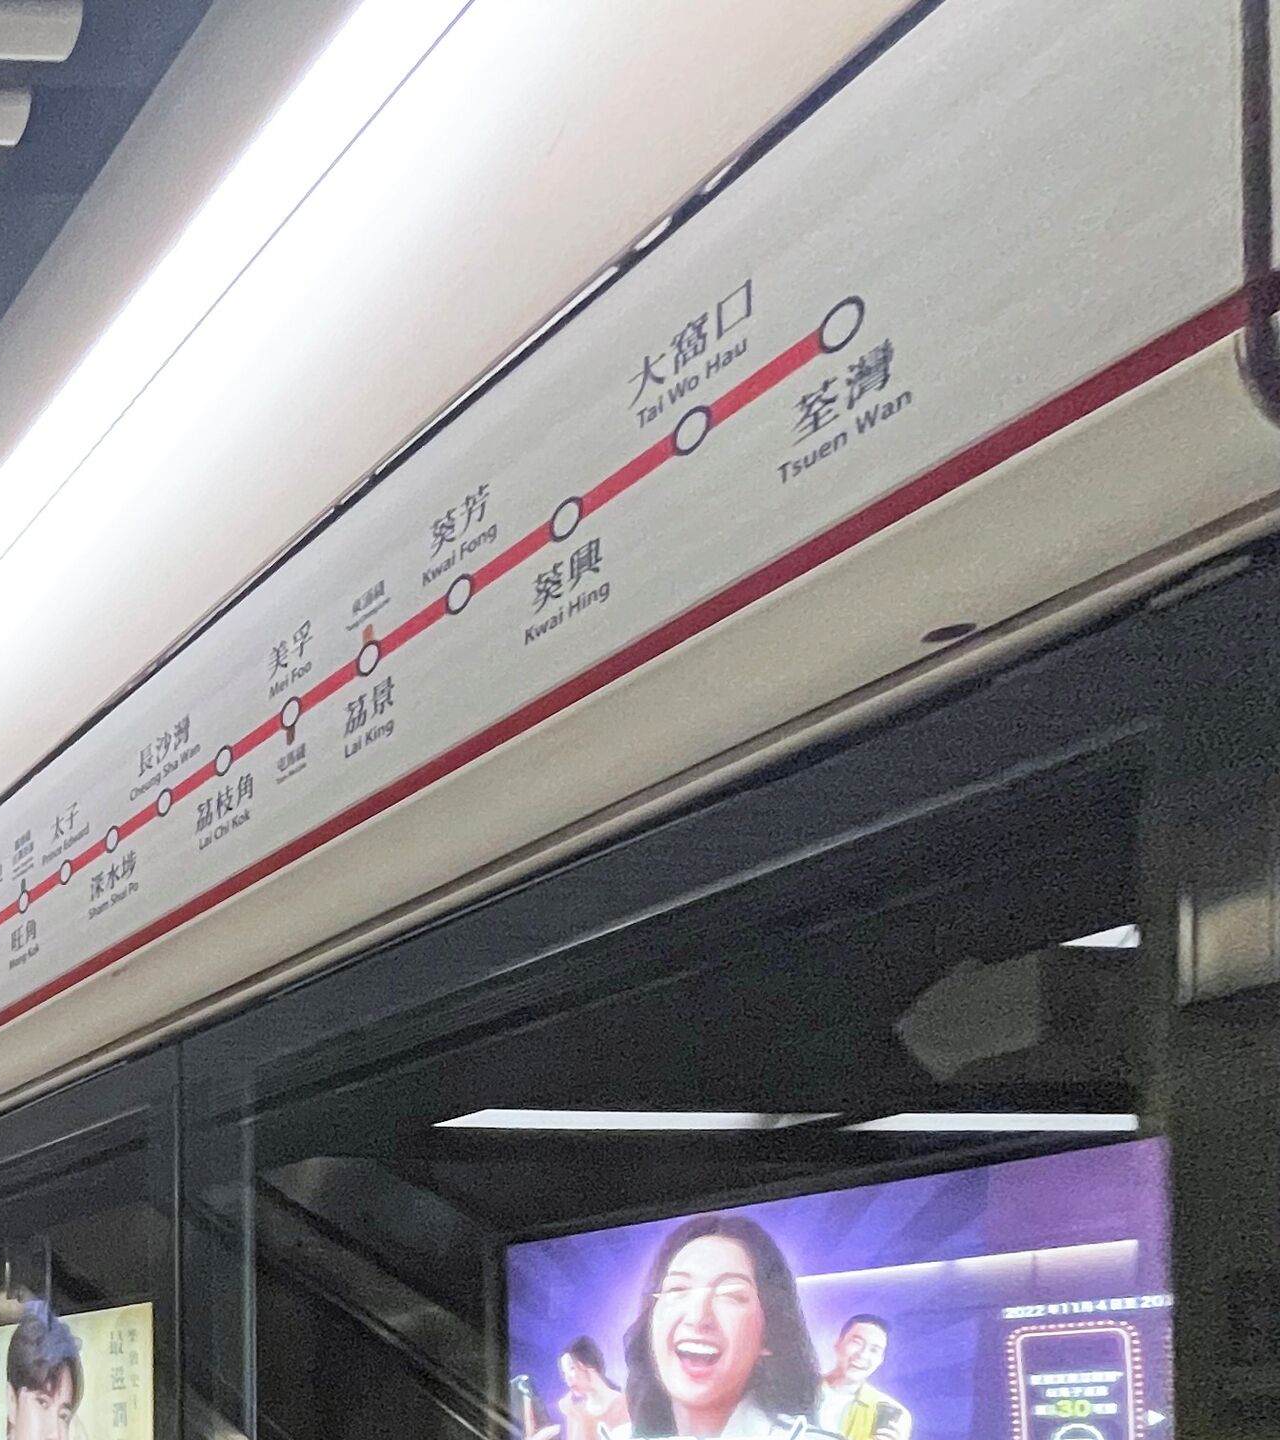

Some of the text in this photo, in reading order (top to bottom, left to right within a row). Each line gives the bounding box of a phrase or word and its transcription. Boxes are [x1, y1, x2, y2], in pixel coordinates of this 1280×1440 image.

[628, 279, 752, 408] 大窩口
[637, 338, 748, 430] Tai Wo Hau
[791, 338, 894, 447] 荃灣
[777, 390, 913, 484] Tsuen Wan
[430, 483, 490, 558] 葵芳
[422, 523, 498, 587] Kwai Fong
[534, 537, 603, 614] 葵興
[524, 582, 611, 645] Kwai Hing
[269, 620, 314, 681] 美孚
[269, 661, 312, 700] Mei Foo
[344, 676, 395, 738] 荔景
[344, 719, 395, 759] Lai King
[51, 802, 80, 844] 太子
[195, 772, 254, 835] 荔枝角
[198, 808, 251, 850] Lai Chi Kok
